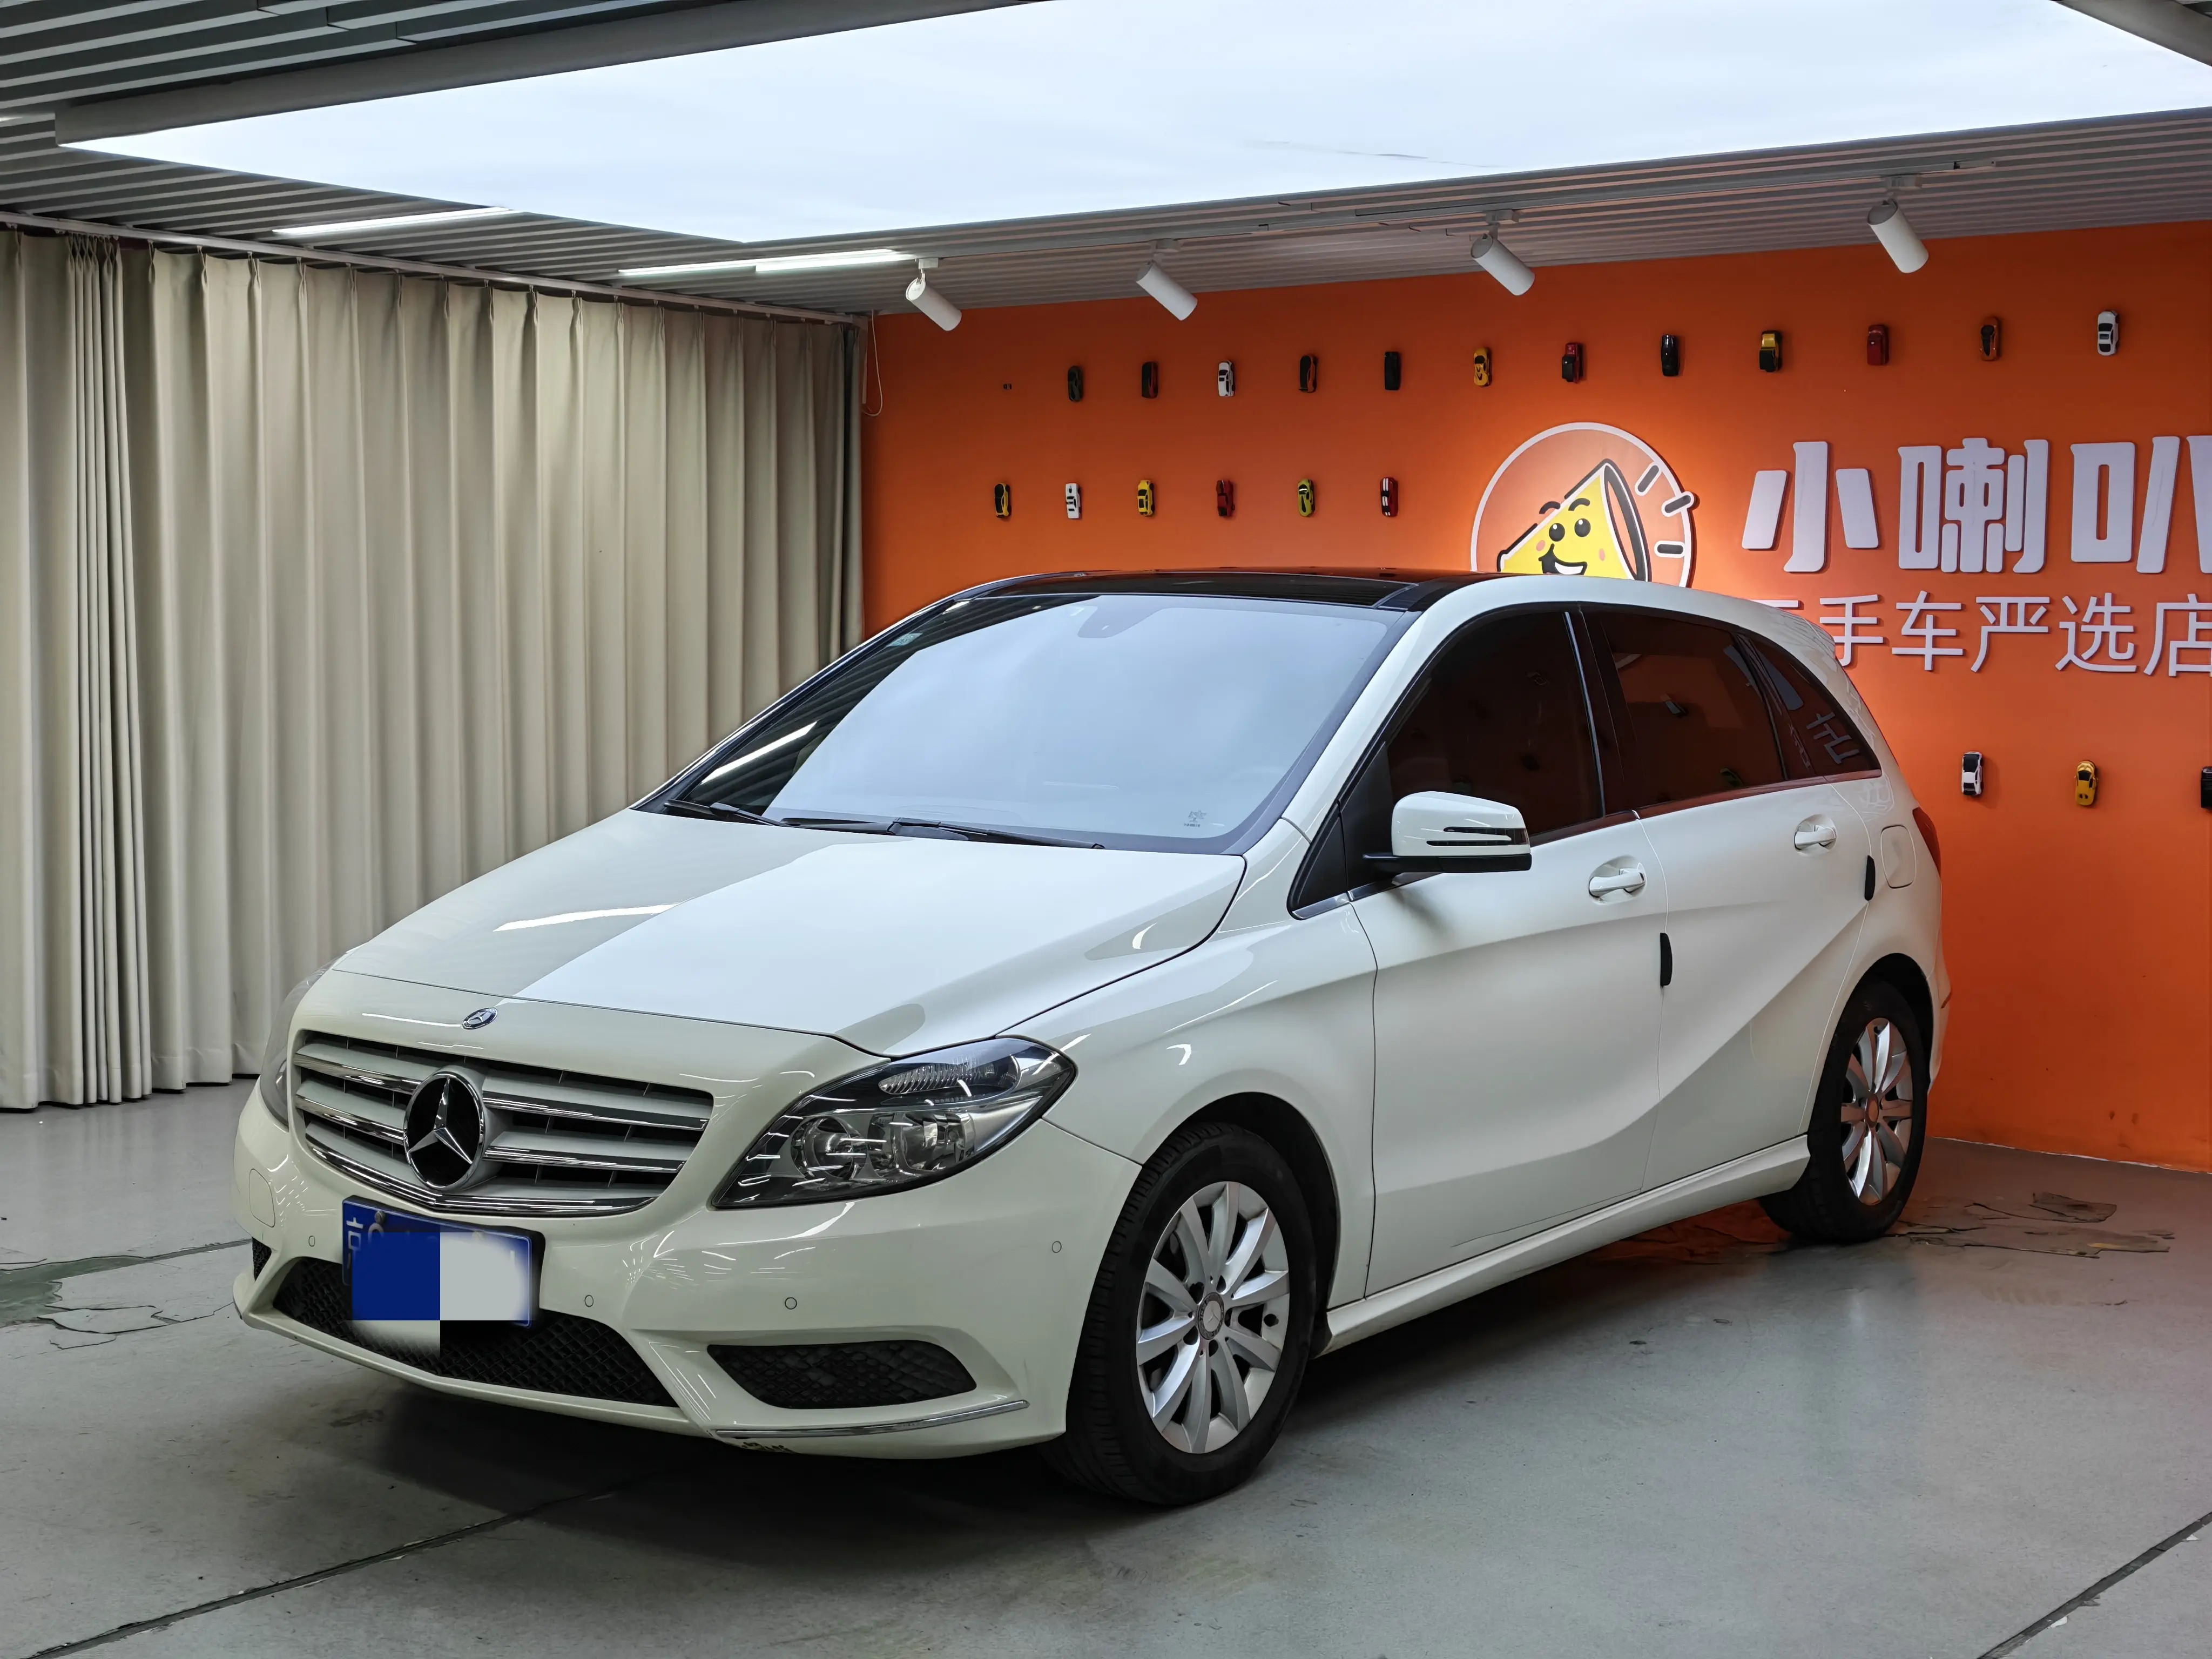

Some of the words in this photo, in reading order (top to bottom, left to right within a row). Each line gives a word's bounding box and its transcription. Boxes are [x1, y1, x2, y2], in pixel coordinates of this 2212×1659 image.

[1742, 435, 2212, 574] 小喇叭
[1750, 591, 2212, 677] 手车严选店
